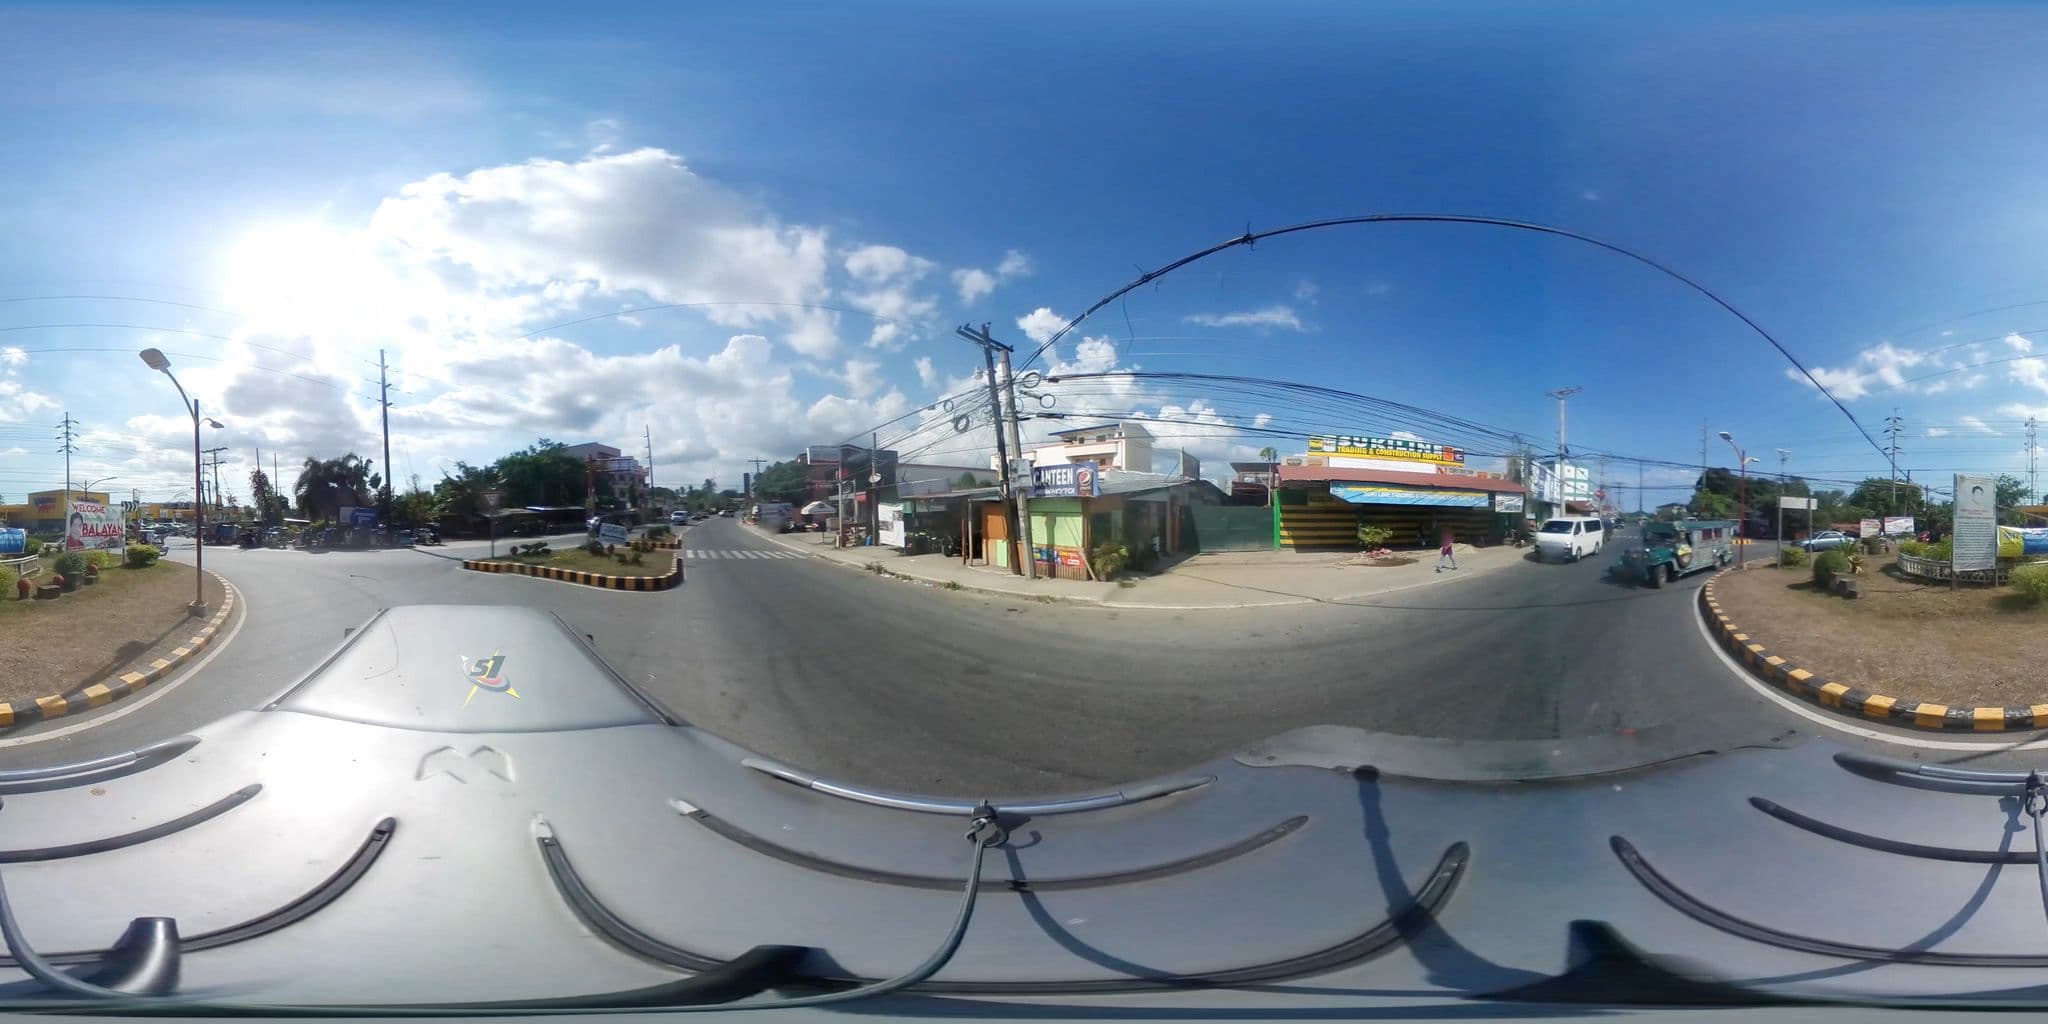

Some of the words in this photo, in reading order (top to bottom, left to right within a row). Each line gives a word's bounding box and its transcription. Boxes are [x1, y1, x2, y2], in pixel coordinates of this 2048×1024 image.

[1337, 446, 1367, 455] TRADING
[1375, 448, 1421, 459] CONSTRUCTION
[1422, 452, 1443, 461] SUPPLY
[1033, 468, 1074, 486] CANTEEN
[72, 503, 105, 513] WELCOME
[82, 523, 124, 538] BALAYAN
